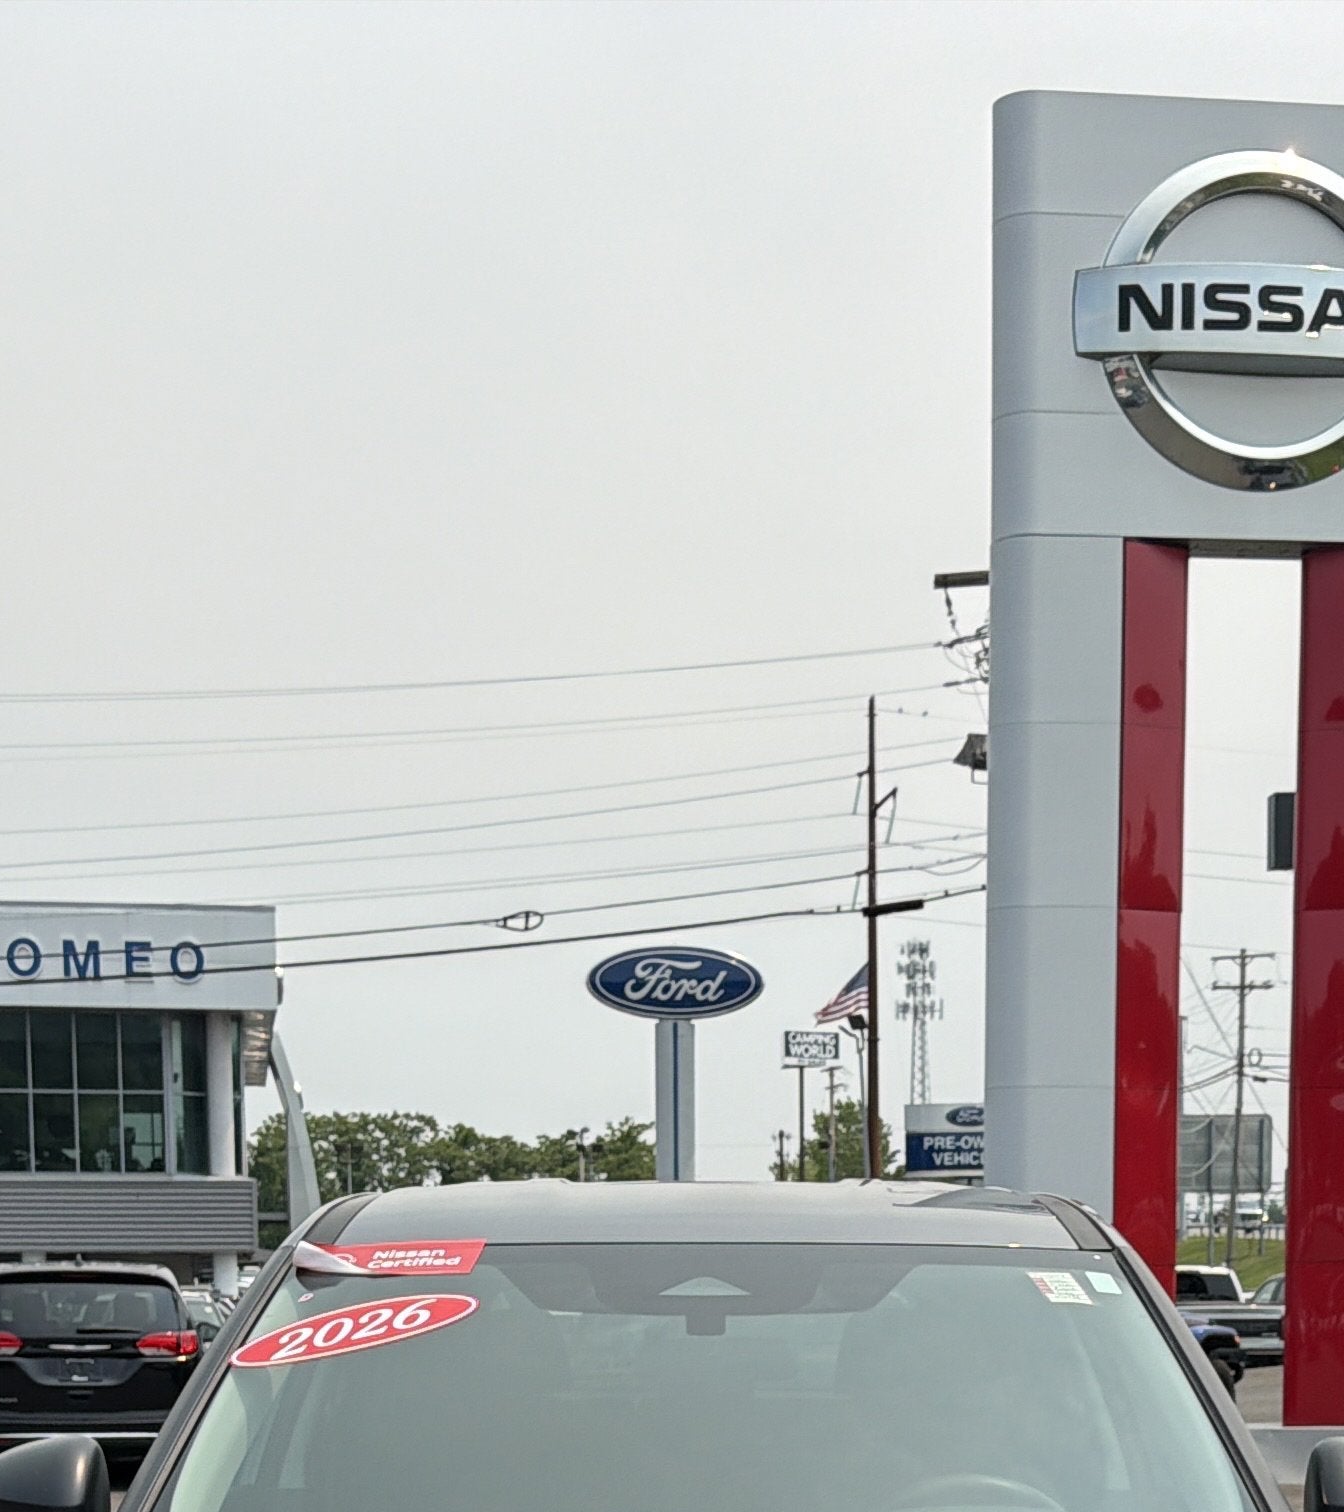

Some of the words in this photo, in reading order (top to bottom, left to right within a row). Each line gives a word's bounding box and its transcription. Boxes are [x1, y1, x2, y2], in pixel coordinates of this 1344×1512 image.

[624, 957, 728, 1002] Ford
[789, 1044, 836, 1058] WORLD
[373, 1250, 445, 1259] Nissan
[367, 1257, 462, 1269] Certified
[270, 1298, 438, 1361] 2026
